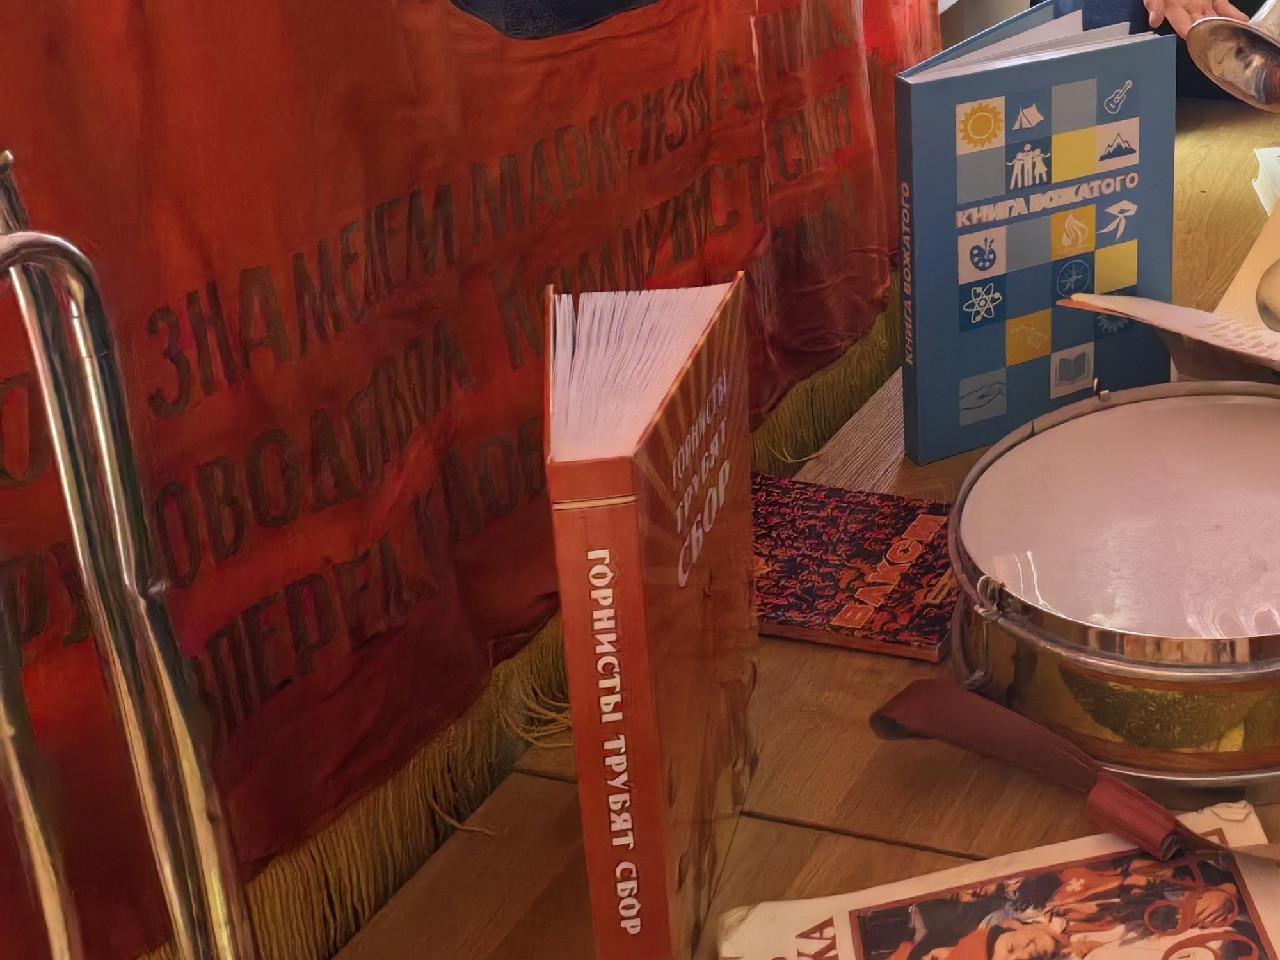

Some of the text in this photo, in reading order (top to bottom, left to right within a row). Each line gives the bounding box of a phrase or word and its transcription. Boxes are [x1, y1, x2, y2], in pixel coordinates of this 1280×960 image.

[956, 172, 1139, 227] КНИГА ВОЖАТОГО
[902, 182, 915, 366] КНИГА ВОЖАТОГО
[676, 417, 728, 534] ТРУБЯТ
[678, 460, 731, 588] СБОР
[586, 548, 642, 937] ГОРНИСТЫ ТРУБЯТ СБОР
